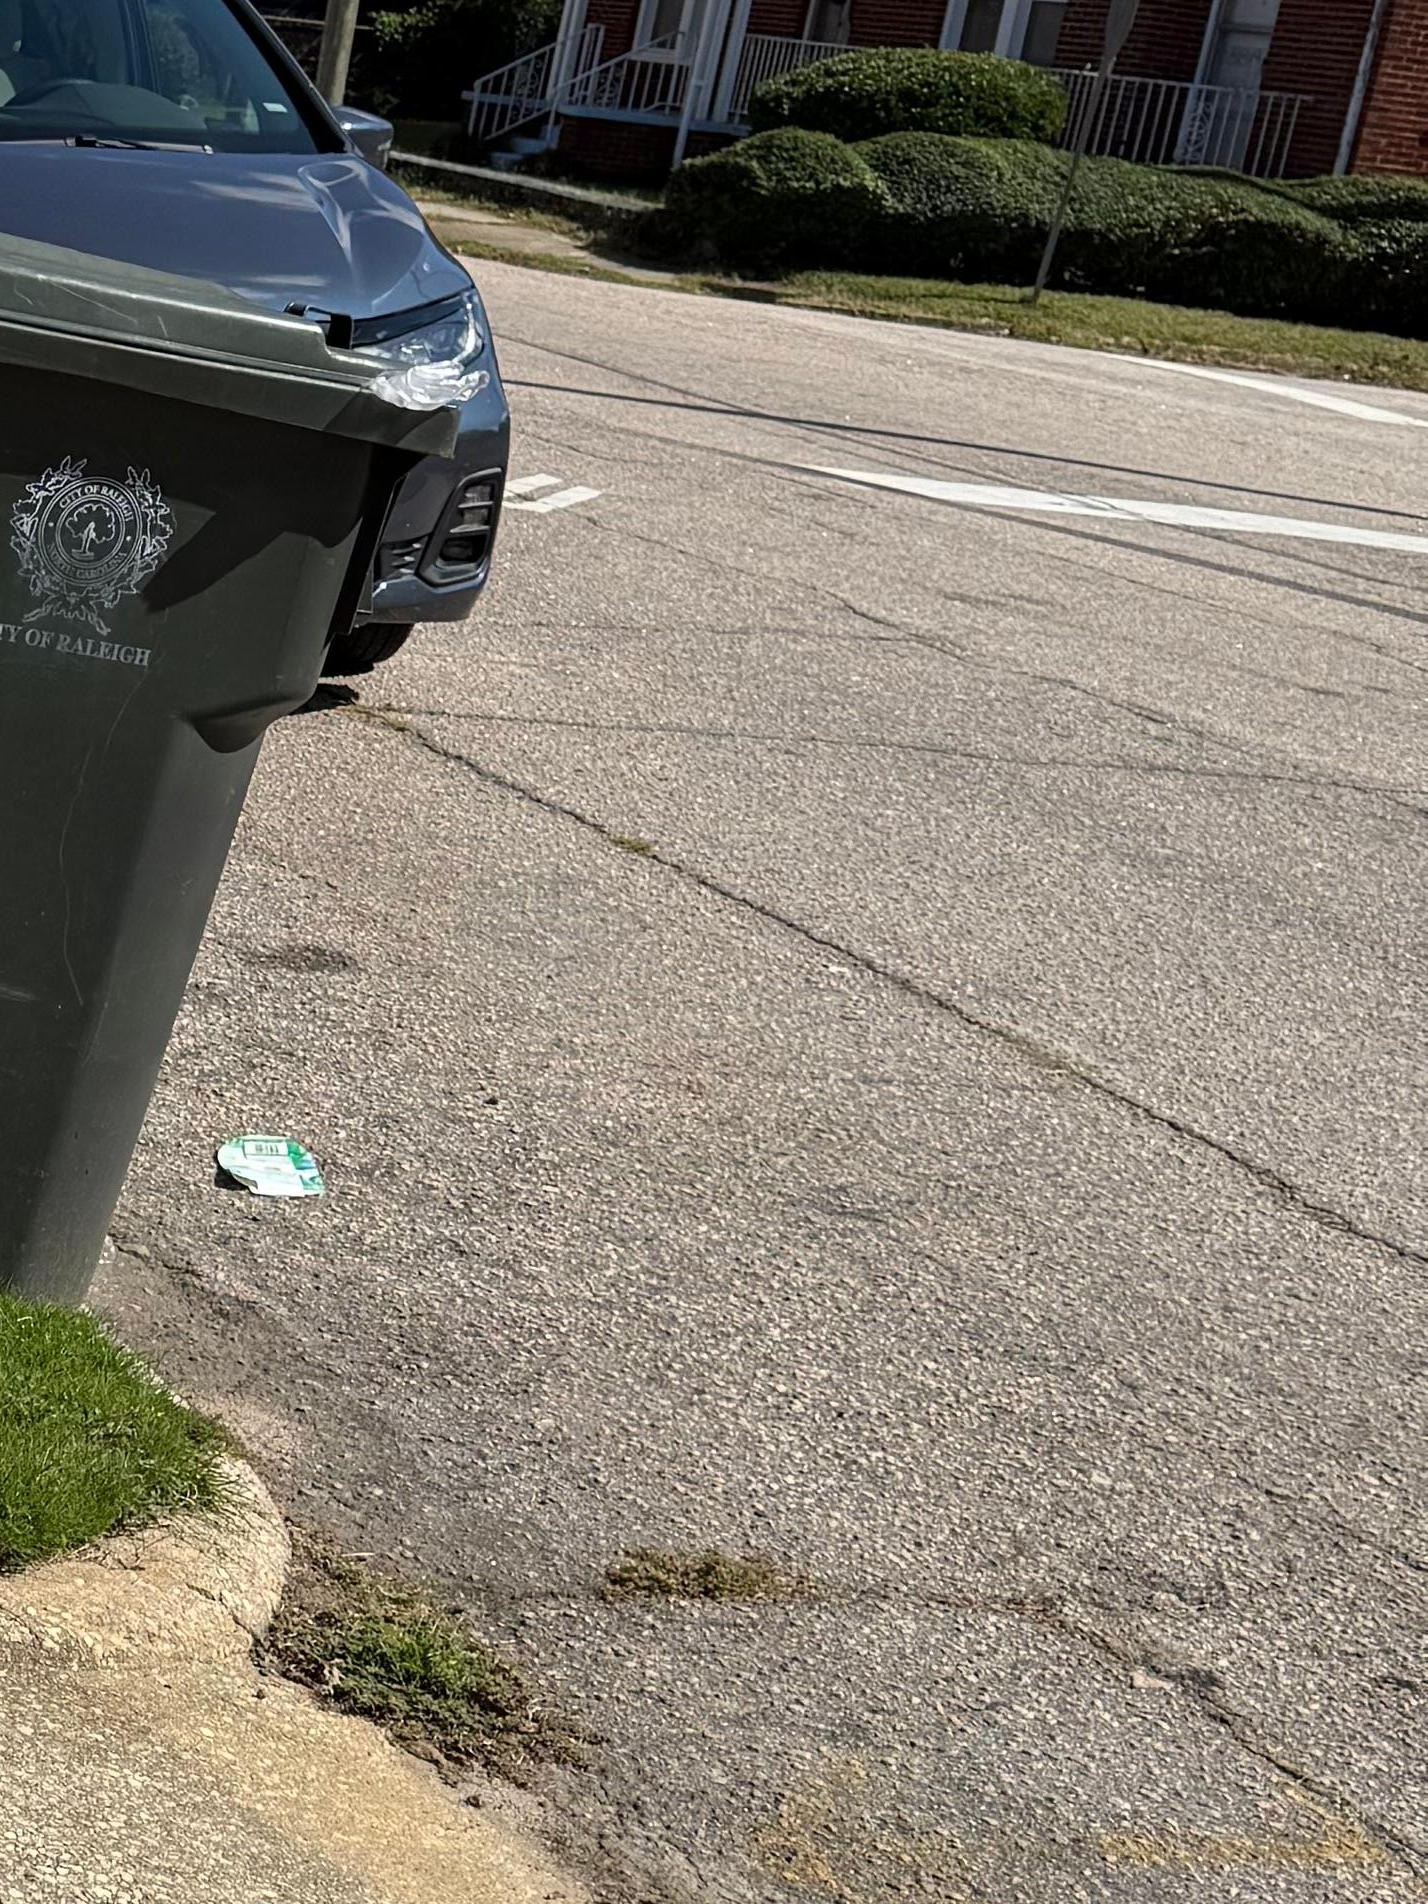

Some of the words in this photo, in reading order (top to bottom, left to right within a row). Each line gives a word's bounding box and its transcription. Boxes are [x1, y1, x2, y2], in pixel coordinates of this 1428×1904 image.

[59, 487, 82, 509] CITY
[84, 485, 100, 495] OF
[100, 485, 134, 522] RALEIGH
[25, 628, 55, 648] OF
[55, 633, 152, 666] RALEIGH
